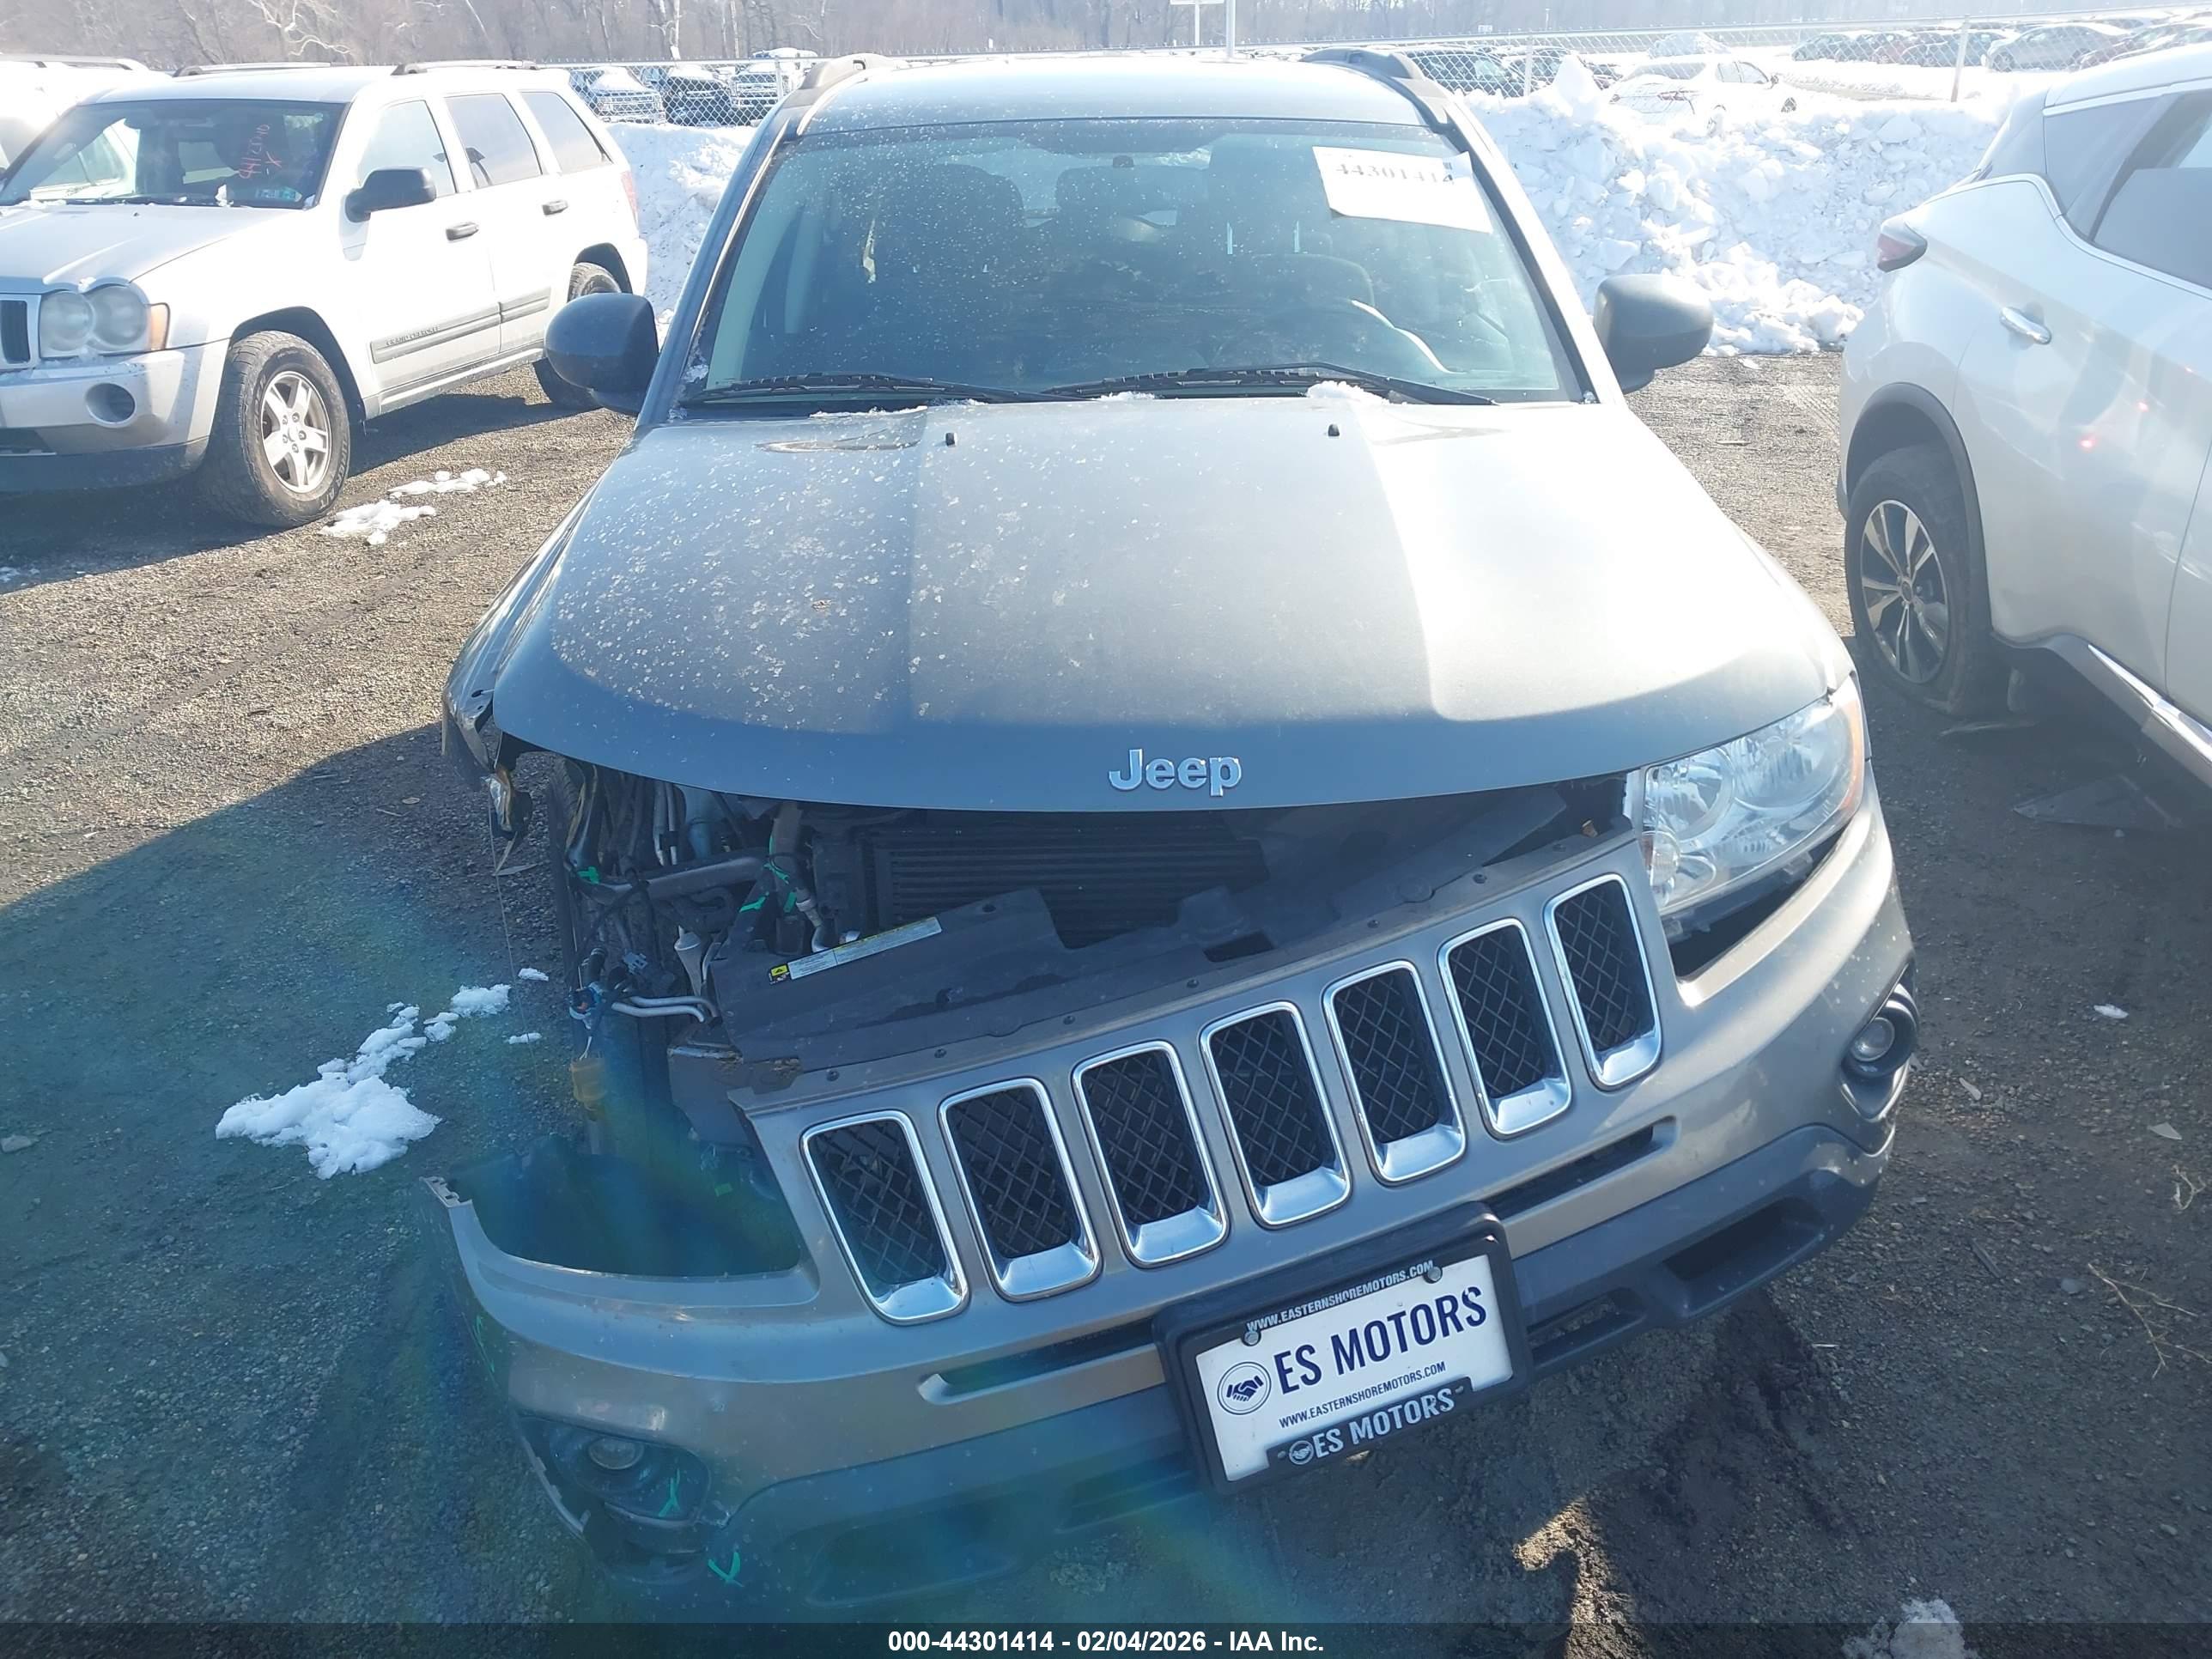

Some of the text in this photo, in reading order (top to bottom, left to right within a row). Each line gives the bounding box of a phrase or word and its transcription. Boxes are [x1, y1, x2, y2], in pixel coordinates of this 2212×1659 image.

[1109, 748, 1242, 797] Jeep
[1247, 1260, 1434, 1332] WWW.EASTERNSHOREMOTORS.COM
[1273, 1285, 1486, 1395] ES MOTORS
[1279, 1361, 1446, 1429] WWW.EASTERNSHOREMOTORS.COM
[1311, 1387, 1455, 1458] ES MOTORS
